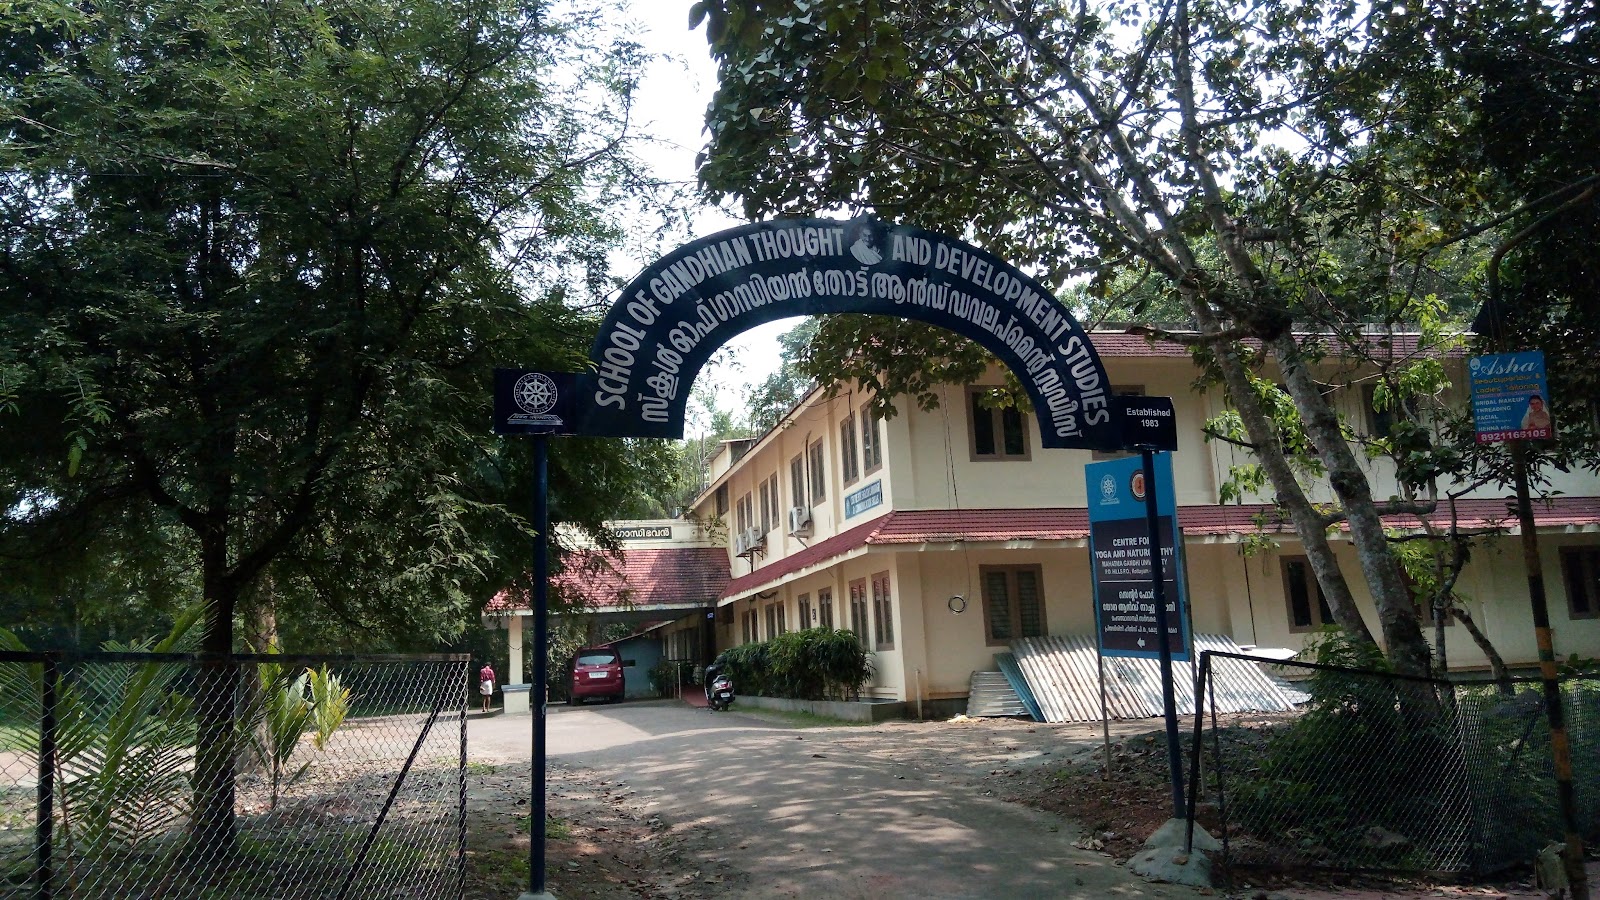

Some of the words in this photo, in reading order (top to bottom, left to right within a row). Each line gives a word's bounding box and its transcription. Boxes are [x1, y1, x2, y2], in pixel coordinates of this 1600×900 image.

[595, 321, 647, 410] SCHOOL
[626, 290, 662, 326] OF
[649, 236, 753, 305] GANDHIAN
[749, 227, 844, 262] THOUGHT
[892, 235, 932, 266] AND
[934, 242, 1073, 343] DEVELOPMENT
[1057, 336, 1110, 427] STUDIES
[669, 298, 720, 354] ഓഫ്
[1478, 357, 1540, 376] Asha
[1126, 407, 1171, 417] Established
[1476, 405, 1512, 413] THREADING
[1140, 418, 1160, 428] 1983
[1481, 429, 1547, 441] 8921165105
[1112, 537, 1137, 546] CENTRE
[1095, 550, 1112, 559] YOGA
[1113, 550, 1125, 558] AND
[1127, 547, 1174, 558] NATURTHY
